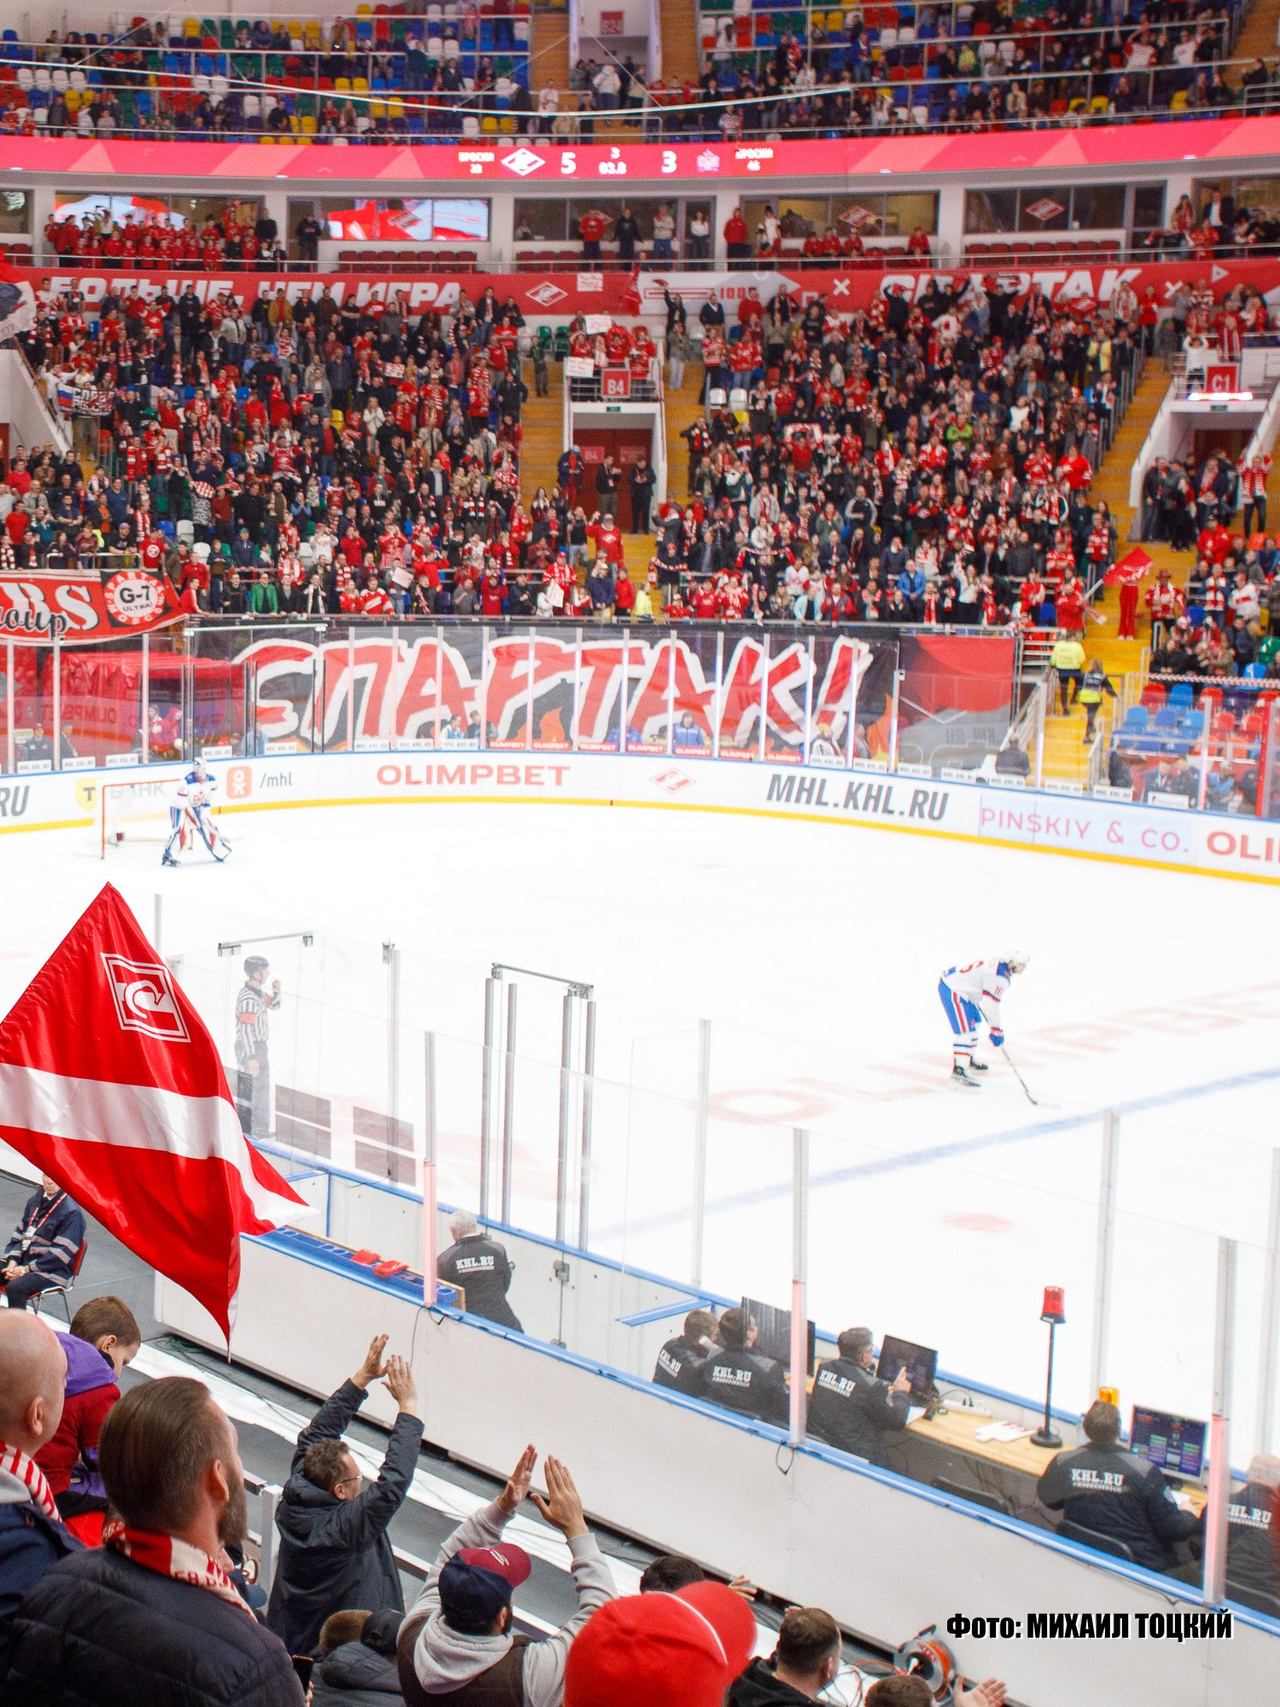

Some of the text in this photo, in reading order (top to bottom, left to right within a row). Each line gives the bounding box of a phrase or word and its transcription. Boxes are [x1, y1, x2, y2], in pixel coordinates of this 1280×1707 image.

[561, 151, 577, 175] 5
[610, 146, 621, 160] 3
[661, 150, 678, 174] 3
[356, 281, 461, 308] ИГРА
[607, 378, 624, 395] B4
[119, 584, 151, 604] G-7
[232, 634, 874, 750] СПАРТАК!
[258, 771, 293, 789] /mhl
[376, 764, 571, 787] OLIMPBET
[766, 773, 950, 822] MHL.KHL.RU
[981, 807, 1189, 853] PINSKIY & CO.
[1207, 831, 1280, 864] OLI
[456, 1255, 495, 1270] KHL.RU
[657, 1348, 682, 1375] KHL.RU
[712, 1365, 753, 1383] KHL.RU
[819, 1369, 856, 1392] KHL.RU
[1071, 1468, 1125, 1487] KHL.RU
[1227, 1503, 1272, 1524] HL.RU
